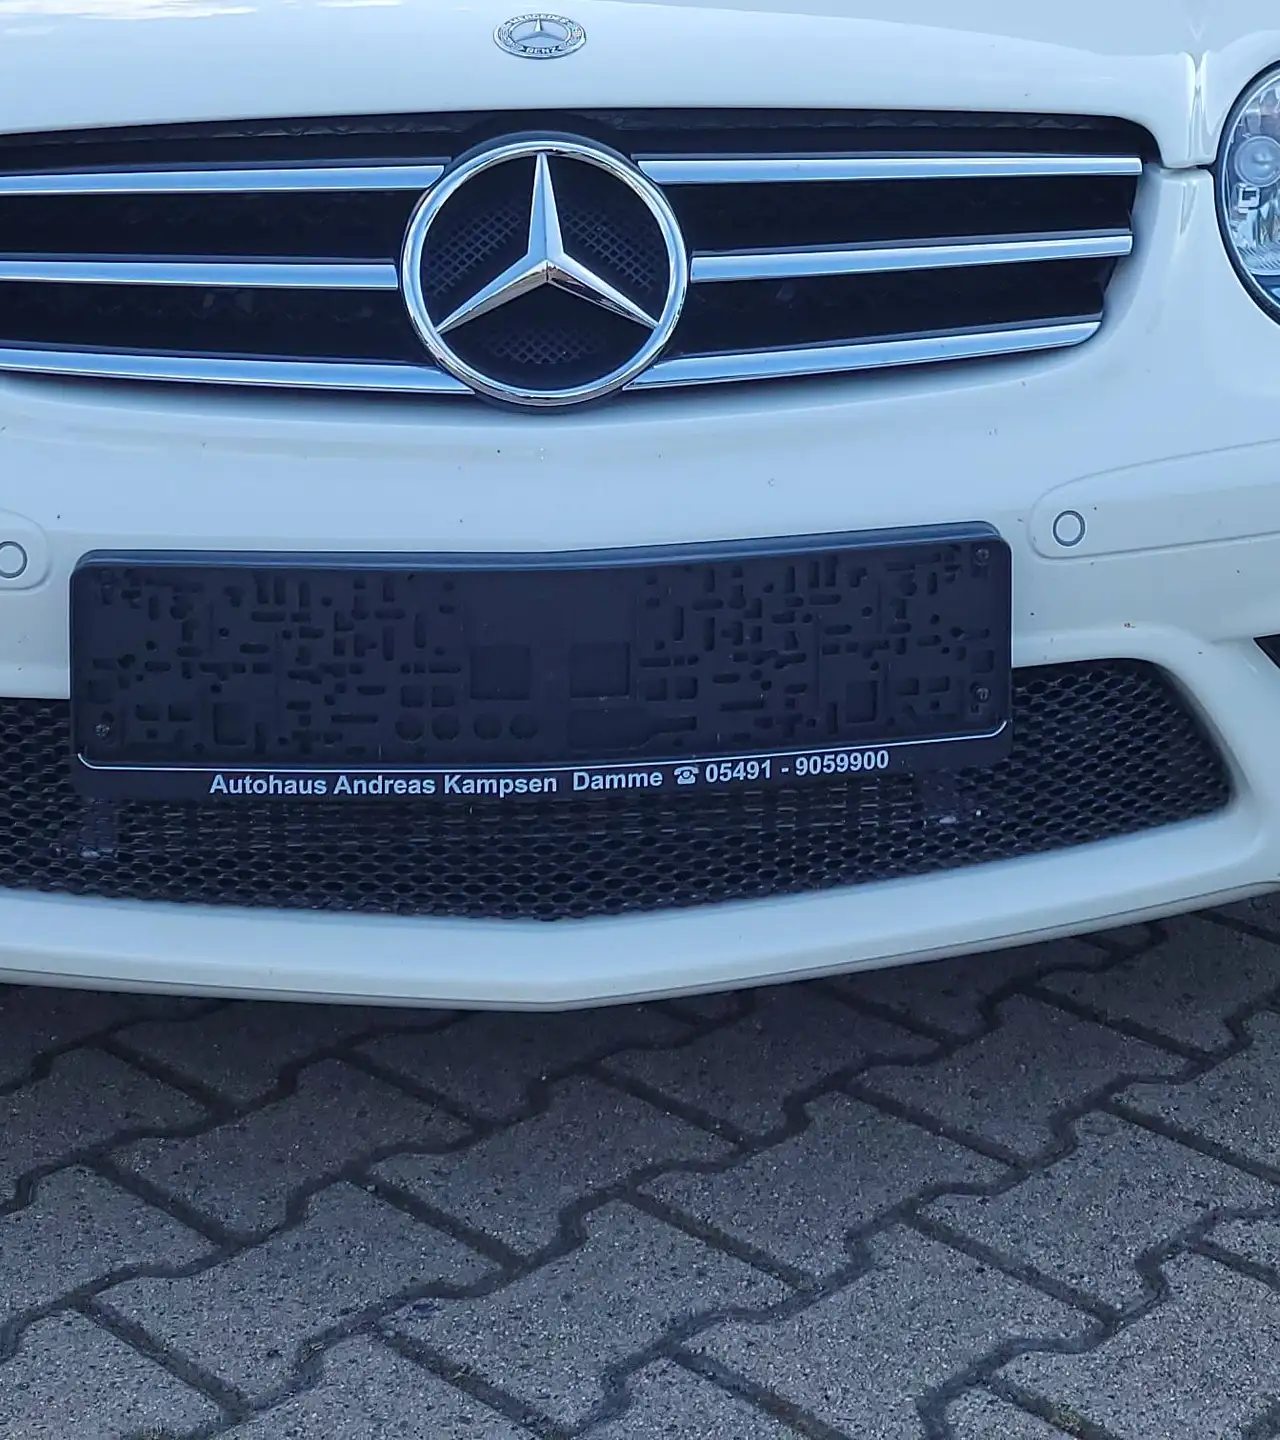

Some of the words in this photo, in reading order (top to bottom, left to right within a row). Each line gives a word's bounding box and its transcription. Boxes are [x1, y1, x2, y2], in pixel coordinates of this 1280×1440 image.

[209, 774, 327, 795] Autohaus
[333, 774, 436, 795] Andreas
[443, 773, 557, 798] Kampsen
[572, 770, 663, 791] Damme
[705, 759, 772, 783] 05491
[795, 750, 889, 776] 9059900
